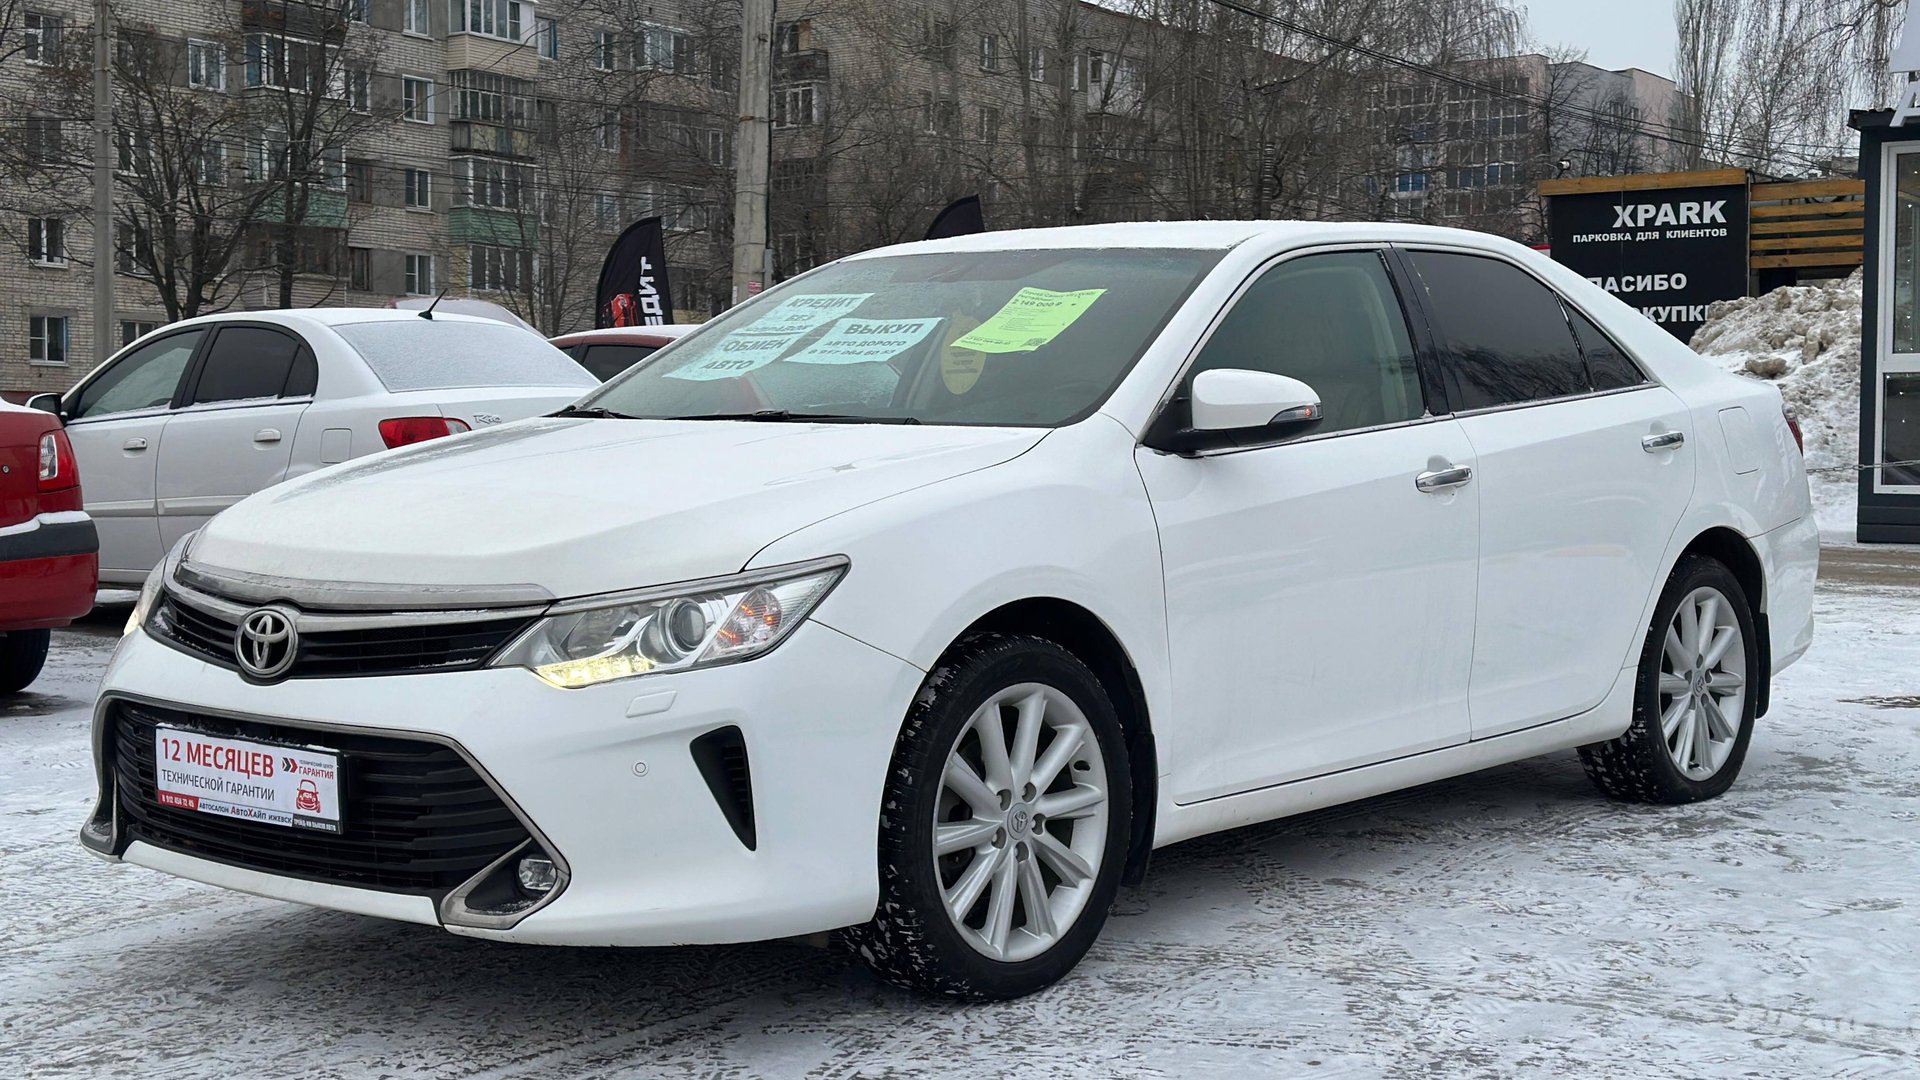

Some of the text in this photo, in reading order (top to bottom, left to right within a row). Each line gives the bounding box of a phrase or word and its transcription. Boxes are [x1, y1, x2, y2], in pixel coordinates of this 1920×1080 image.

[1612, 200, 1727, 228] XPARK
[1573, 228, 1727, 243] ПАРКОВКА ДЛЯ КЛИЕНТОВ
[786, 297, 860, 309] КРЕДИТ
[1632, 304, 1710, 323] КУПК
[844, 323, 924, 335] ВЫКУП
[723, 338, 791, 352] ОБМЕН
[701, 360, 755, 370] АВТО
[162, 738, 274, 779] 12 МЕСЯЦЕВ
[299, 766, 334, 780] ГАРАНТИЯ
[161, 769, 275, 801] ТЕХНИЧЕСКОЙ ГАРАНТИИ
[200, 803, 229, 813] АВТОСАЛОН
